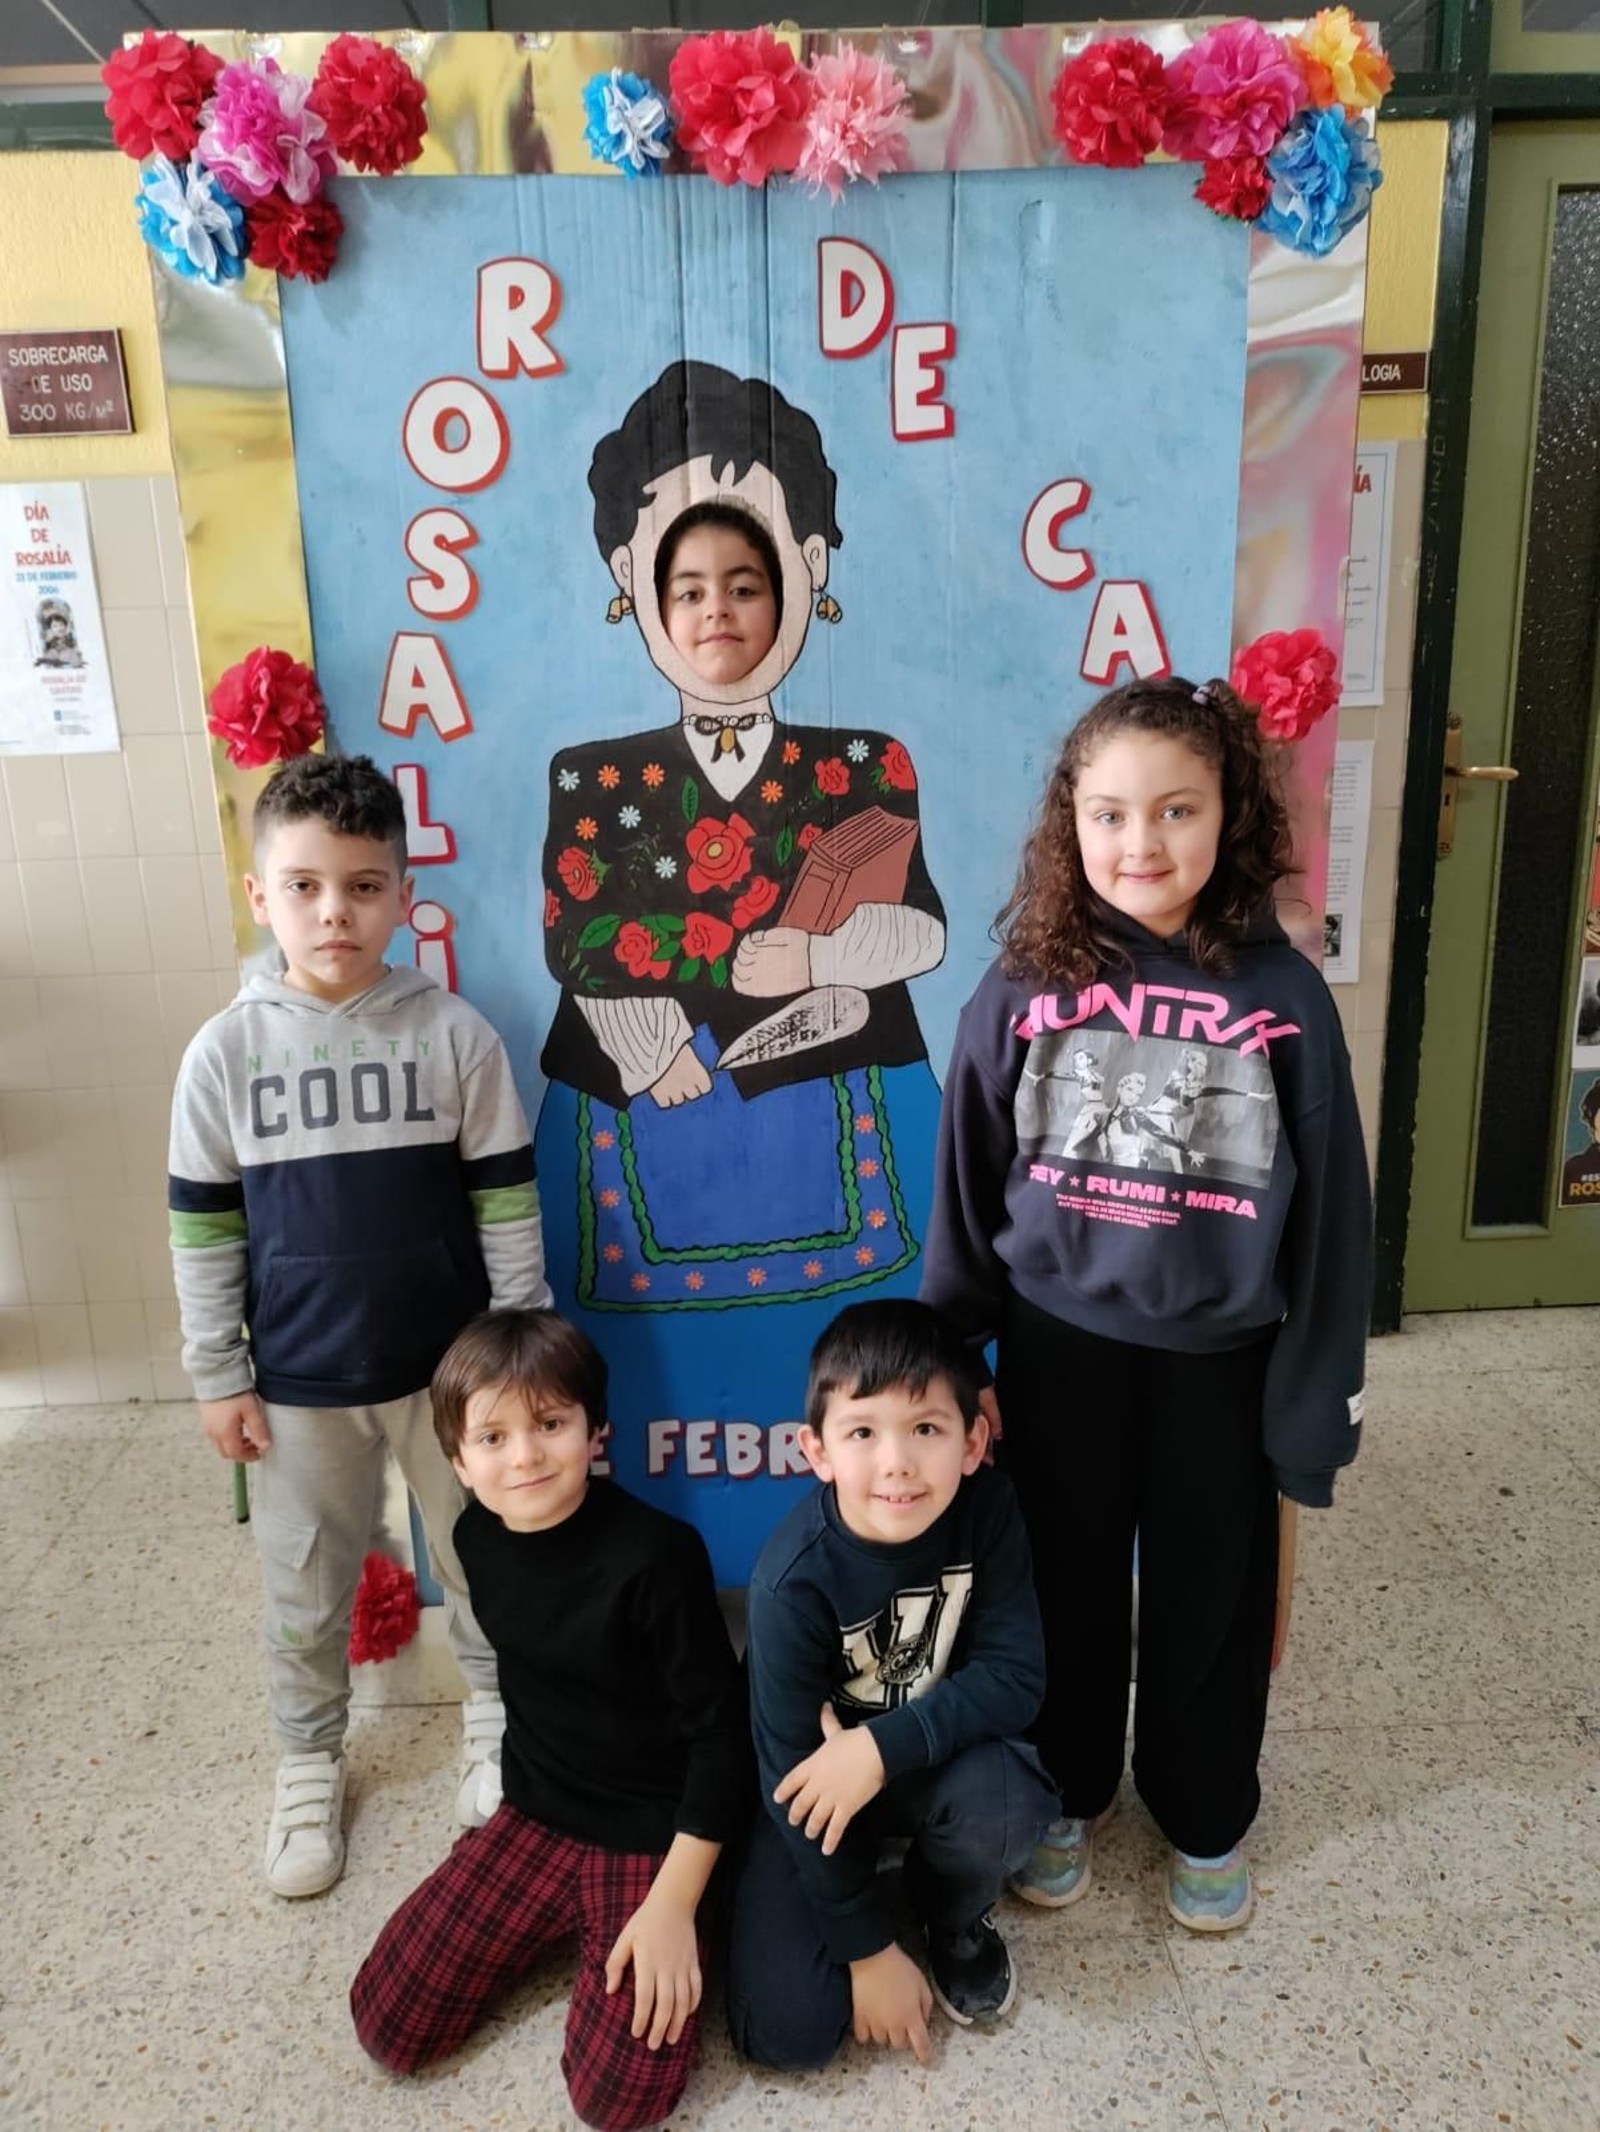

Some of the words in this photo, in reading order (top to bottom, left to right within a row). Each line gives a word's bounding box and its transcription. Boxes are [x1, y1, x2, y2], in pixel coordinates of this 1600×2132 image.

[8, 345, 108, 367] SOBRECARGA
[60, 373, 93, 392] USO
[19, 403, 56, 421] 300
[23, 500, 50, 521] DÍA
[30, 527, 50, 544] DE
[15, 543, 73, 566] ROSALÍA
[248, 1038, 431, 1073] NINETY
[250, 1061, 436, 1139] COOL
[1086, 1175, 1166, 1203] RUMI
[1185, 1190, 1258, 1219] MIRA
